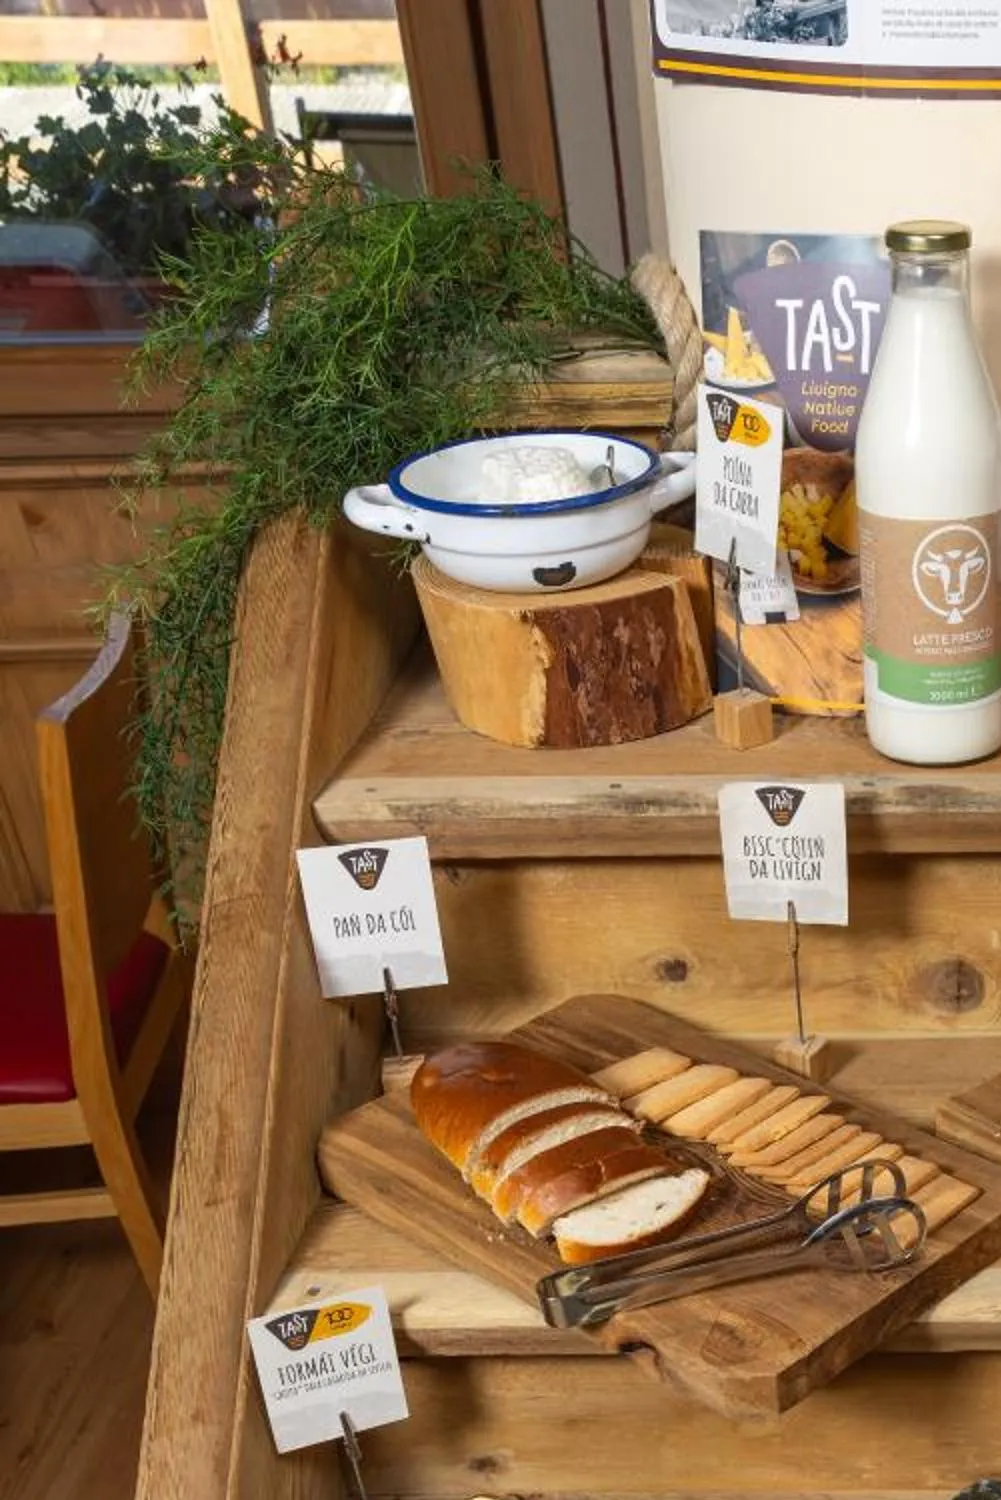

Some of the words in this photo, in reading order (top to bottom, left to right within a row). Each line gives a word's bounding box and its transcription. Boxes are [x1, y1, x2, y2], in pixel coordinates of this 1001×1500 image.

[776, 275, 880, 374] TAST
[801, 381, 858, 398] Livigno
[713, 398, 733, 425] TAST
[804, 402, 856, 416] Native
[811, 418, 848, 433] Food
[766, 789, 794, 811] TAST
[349, 850, 378, 874] TAST
[749, 859, 768, 879] DA
[365, 912, 386, 935] DA
[278, 1314, 309, 1339] TAST
